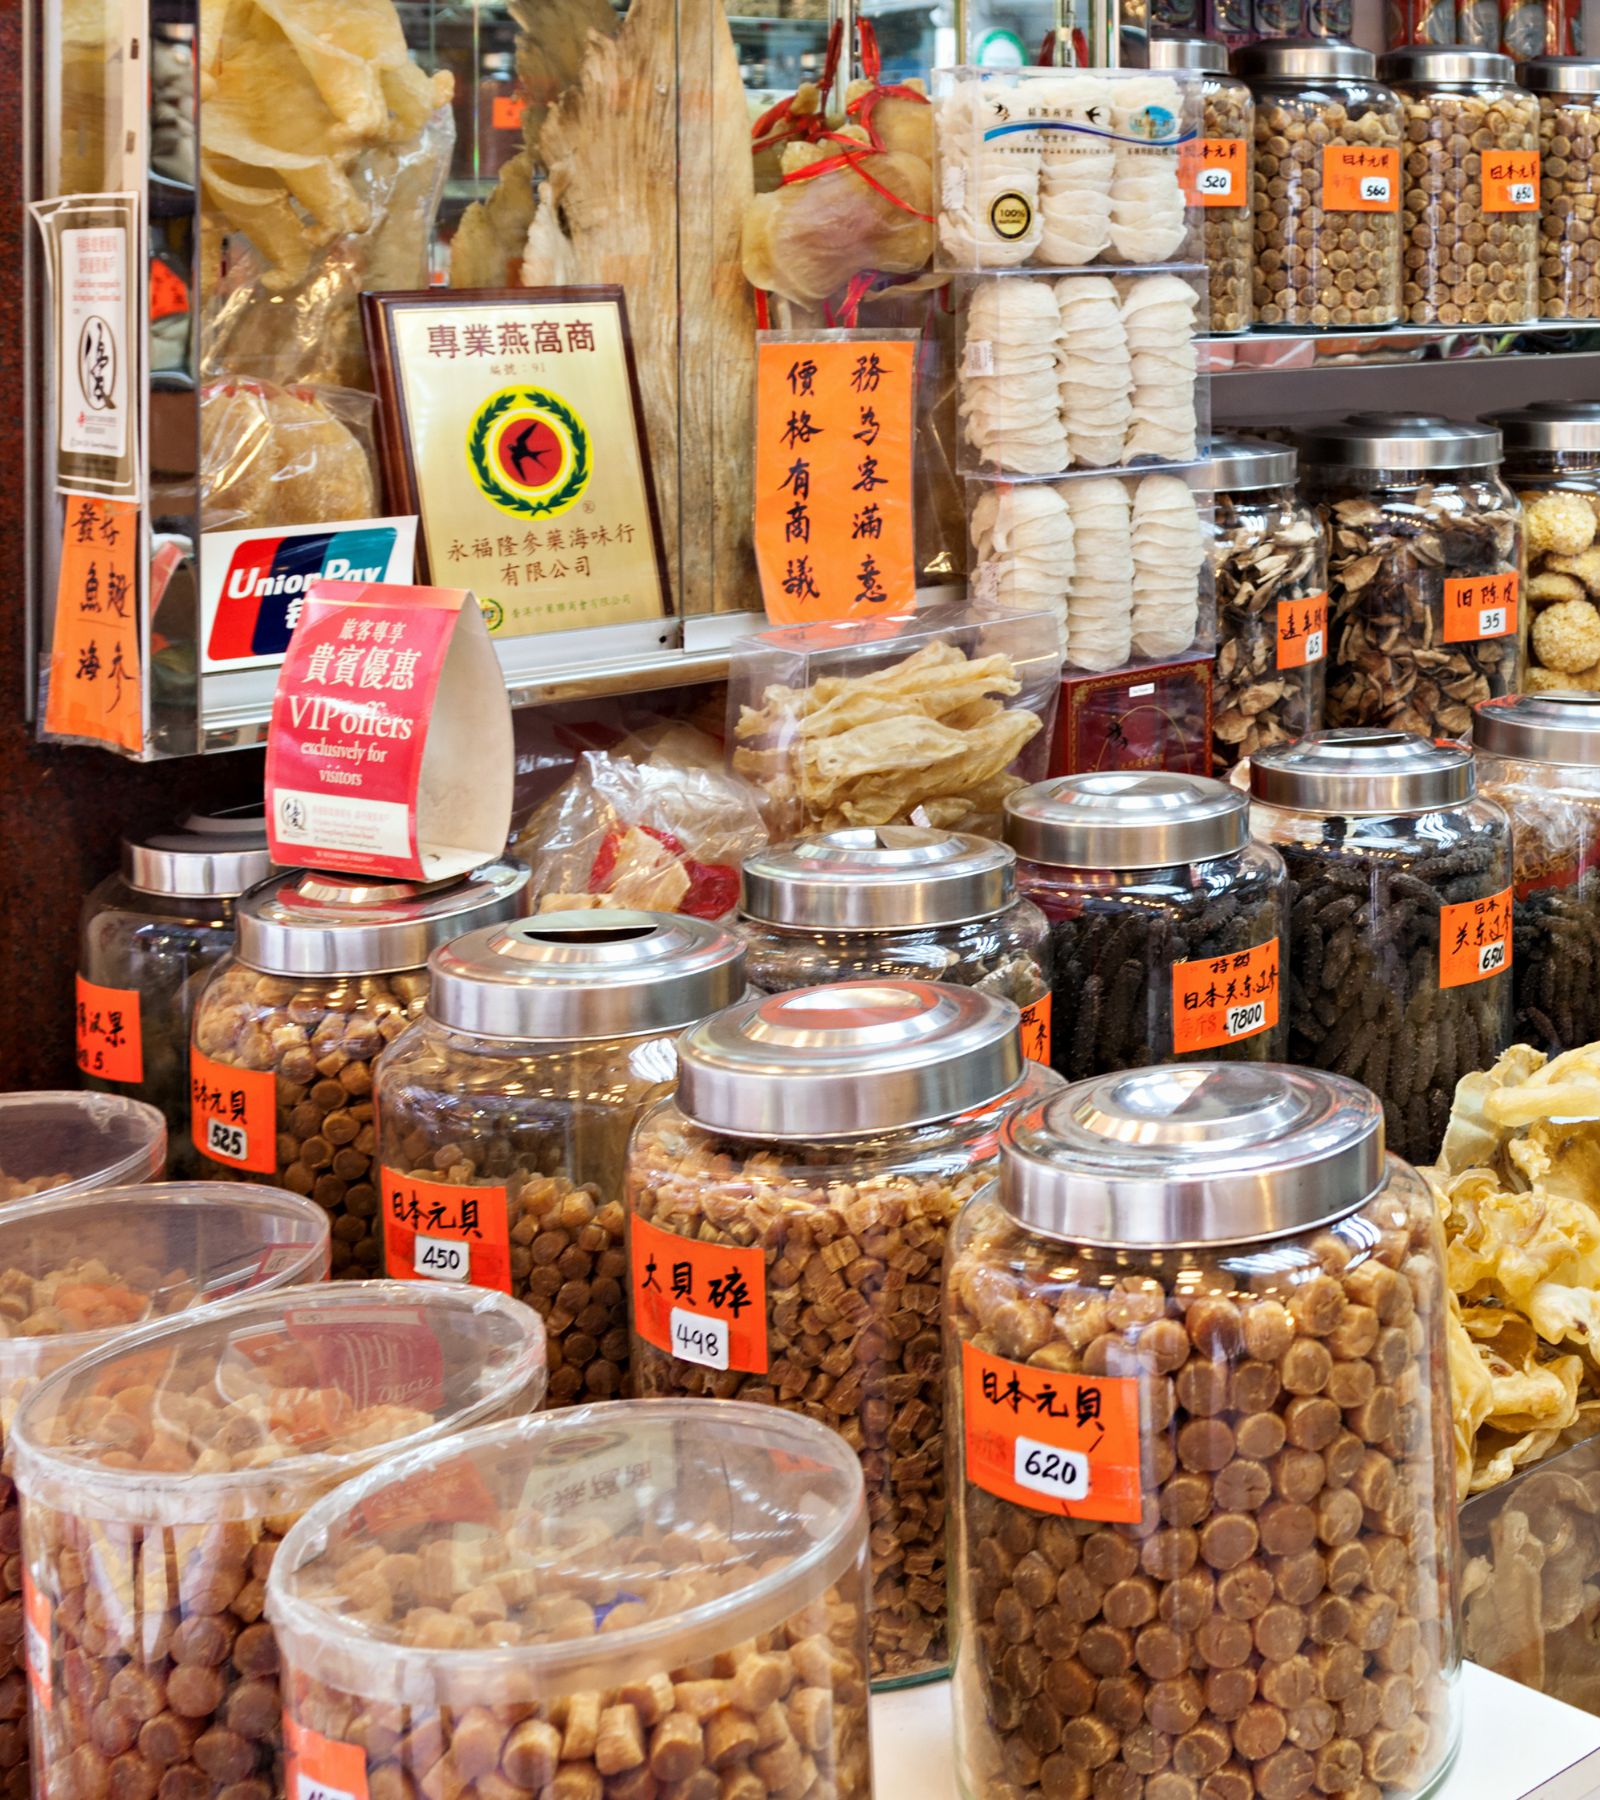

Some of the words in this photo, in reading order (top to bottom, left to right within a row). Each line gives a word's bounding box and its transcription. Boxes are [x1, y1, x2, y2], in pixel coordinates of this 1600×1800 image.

[1204, 174, 1227, 190] 520
[1365, 184, 1387, 198] 560
[426, 319, 597, 359] 專業燕窩商
[500, 555, 592, 588] 有限公司
[337, 617, 408, 644] 旅客專享
[1481, 611, 1501, 631] 35
[301, 642, 423, 691] 貴賓優惠
[288, 691, 341, 733] VIP
[340, 700, 415, 741] offers
[300, 738, 367, 767] exclusively
[367, 741, 389, 764] for
[318, 764, 363, 787] visitors
[1474, 899, 1500, 914] 日本
[1230, 1003, 1263, 1034] 7800
[210, 1123, 244, 1156] 525
[391, 1189, 483, 1240] 日本元貝
[421, 1247, 461, 1272] 450
[640, 1253, 754, 1320] 大貝碎
[675, 1322, 720, 1358] 498
[981, 1367, 1106, 1432] 日本元貝
[1024, 1449, 1078, 1485] 620
